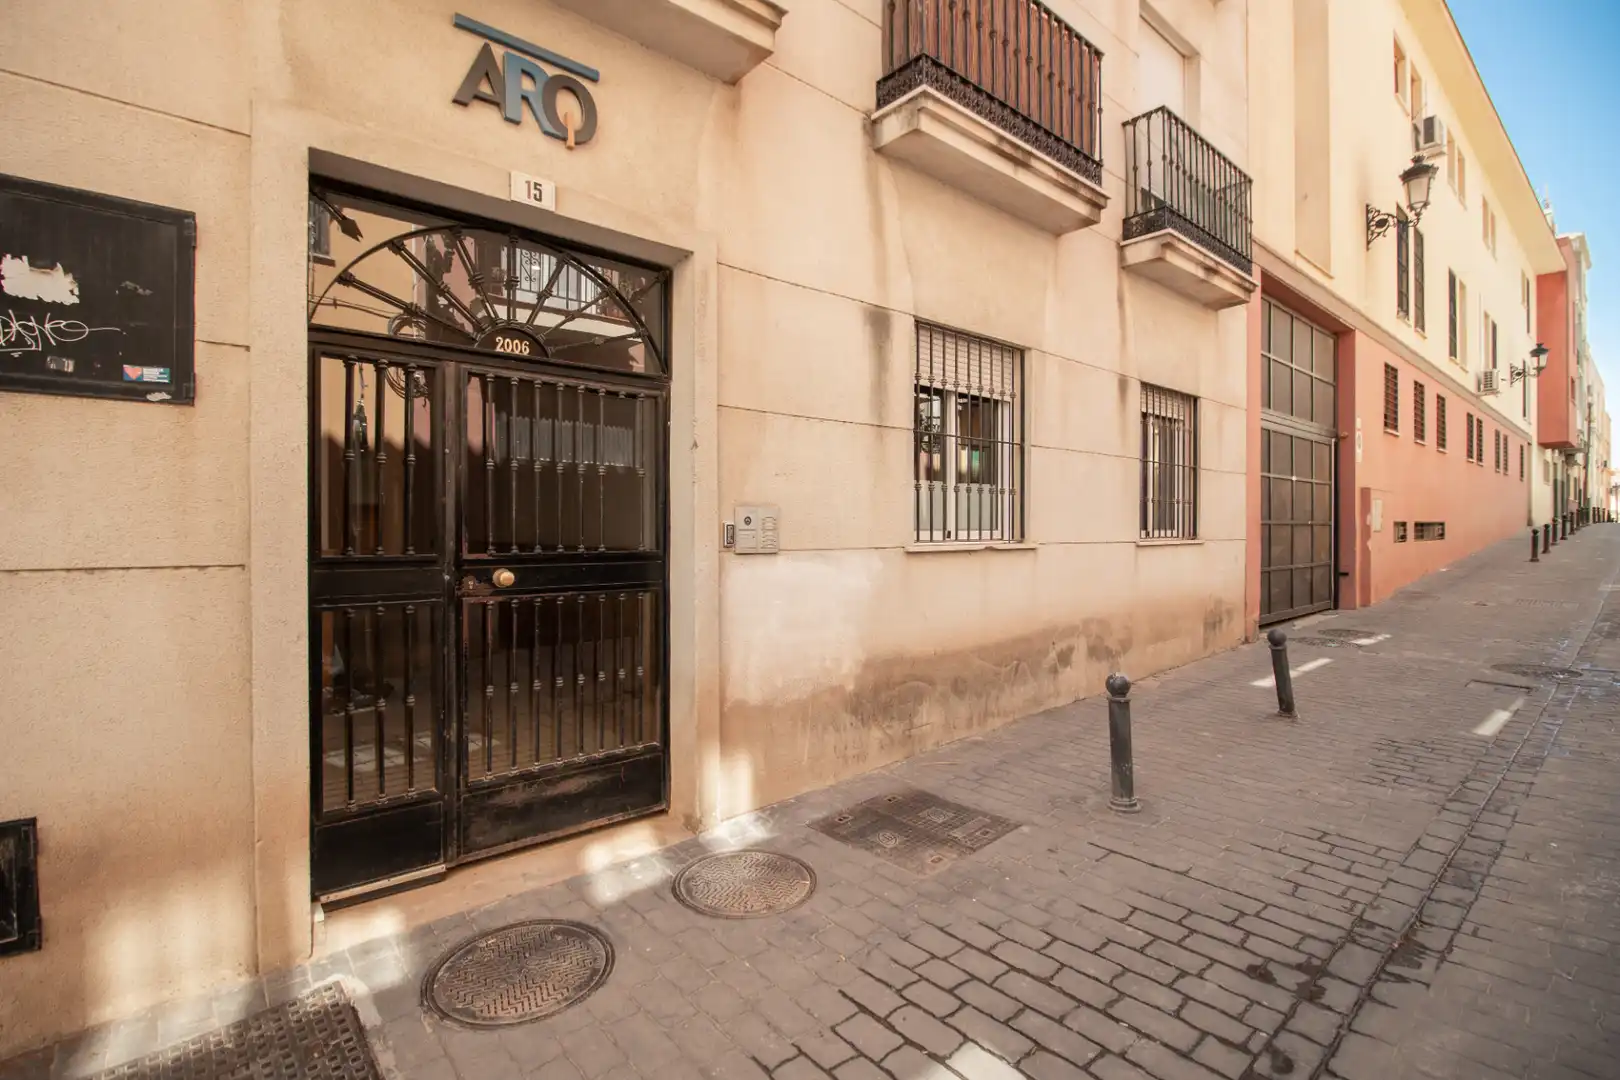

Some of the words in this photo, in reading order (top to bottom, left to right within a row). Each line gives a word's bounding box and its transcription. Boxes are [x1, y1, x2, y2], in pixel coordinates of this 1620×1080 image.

[452, 41, 598, 150] ARQ
[525, 180, 543, 203] 15
[495, 336, 530, 356] 2006
